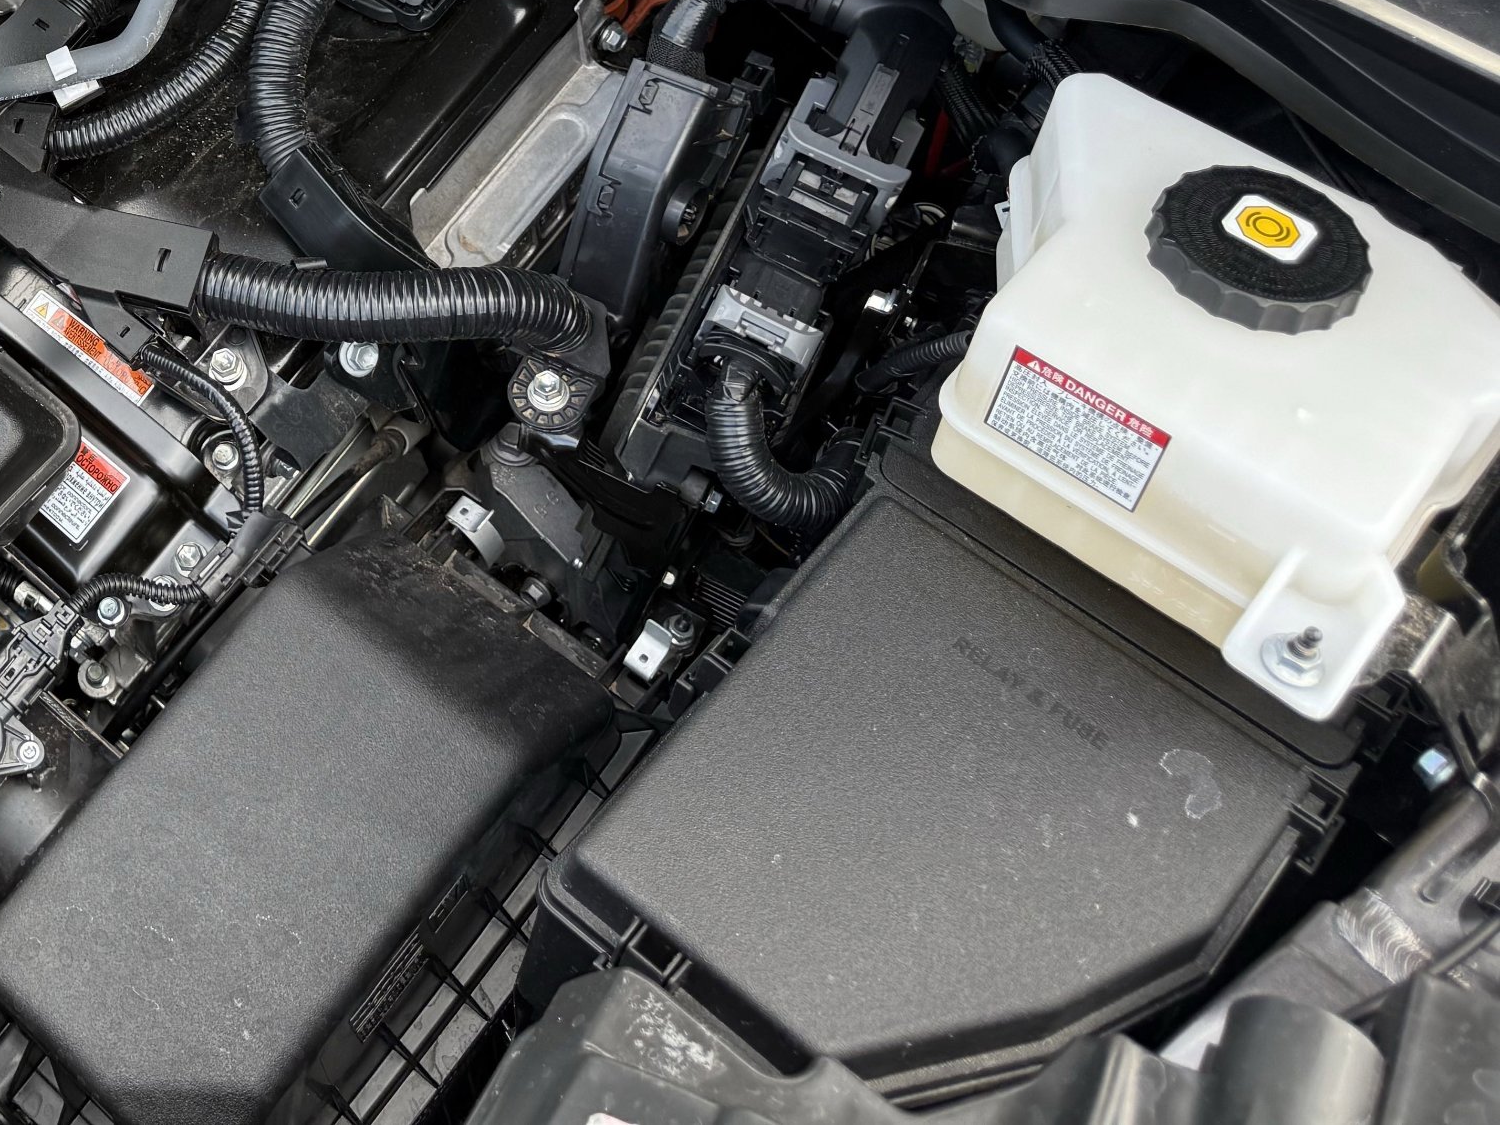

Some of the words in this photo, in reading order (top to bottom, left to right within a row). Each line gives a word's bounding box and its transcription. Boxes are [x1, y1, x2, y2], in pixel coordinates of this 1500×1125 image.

[62, 325, 102, 360] AVERTISSEMENT
[67, 318, 100, 347] WARNING
[997, 401, 1015, 416] AVANT
[1015, 412, 1025, 422] DE
[1062, 440, 1071, 449] LA
[1002, 390, 1030, 410] PRESSION
[1052, 420, 1069, 434] DANS
[1069, 430, 1078, 439] LE
[1105, 452, 1115, 461] DE
[1008, 374, 1025, 388] HIGH
[1025, 385, 1057, 407] PRESSURE
[1059, 404, 1080, 420] INSIDE
[1081, 418, 1103, 434] BRAKE
[1064, 379, 1127, 422] DANGER
[995, 407, 1015, 423] RETIEN
[1015, 419, 1025, 429] OU
[1025, 425, 1035, 435] AU
[1035, 431, 1079, 462] REMPLACEMENT
[1079, 458, 1089, 467] DE
[1089, 464, 1099, 473] LA
[1025, 411, 1034, 420] LA
[1034, 417, 1063, 437] PRESSION
[1063, 434, 1073, 444] DU
[1100, 456, 1110, 466] DE
[1060, 411, 1073, 422] THE
[1074, 420, 1096, 436] BRAKE
[1097, 433, 1123, 452] SYSTEM
[1124, 449, 1150, 468] BEFORE
[1072, 425, 1083, 435] OR
[74, 453, 119, 493] ОСТОРОЖНО
[952, 636, 1023, 687] RELAY
[1047, 702, 1110, 751] FUSE
